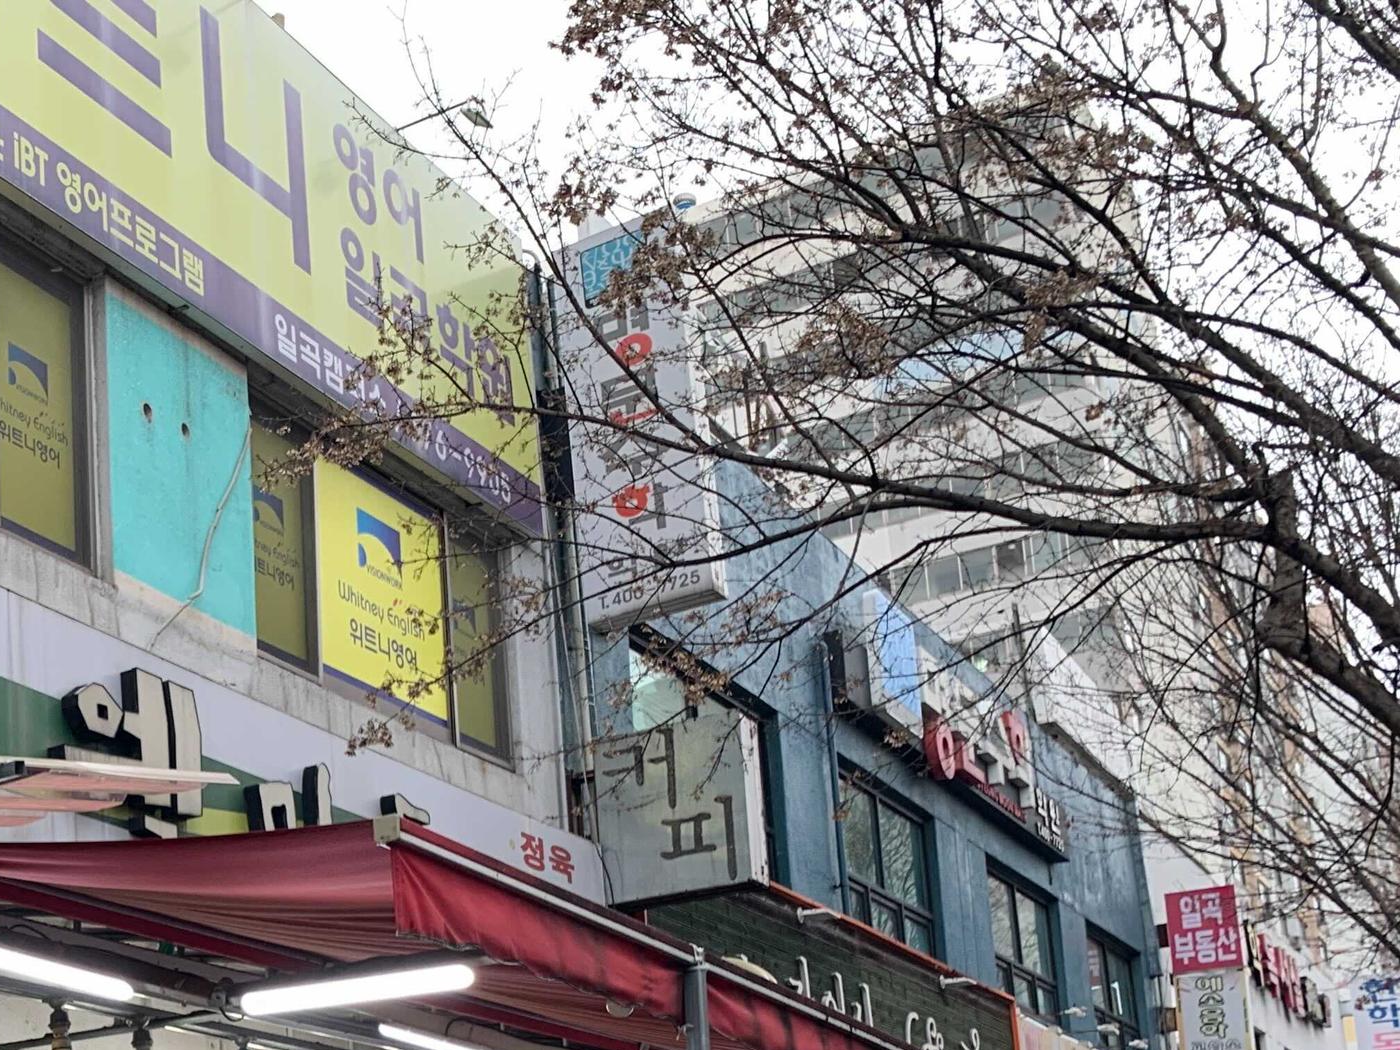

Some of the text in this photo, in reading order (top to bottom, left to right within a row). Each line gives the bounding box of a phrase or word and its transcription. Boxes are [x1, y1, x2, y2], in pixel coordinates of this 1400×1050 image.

[12, 131, 48, 187] iBT
[56, 161, 205, 297] 영어프로그램
[332, 123, 424, 265] 영어
[0, 419, 61, 470] 위트니영어
[338, 579, 385, 624] Whitney
[349, 618, 418, 669] 위트니영어
[520, 832, 575, 884] 정육
[1179, 892, 1224, 930] 일곡
[1173, 926, 1238, 966] 부동산
